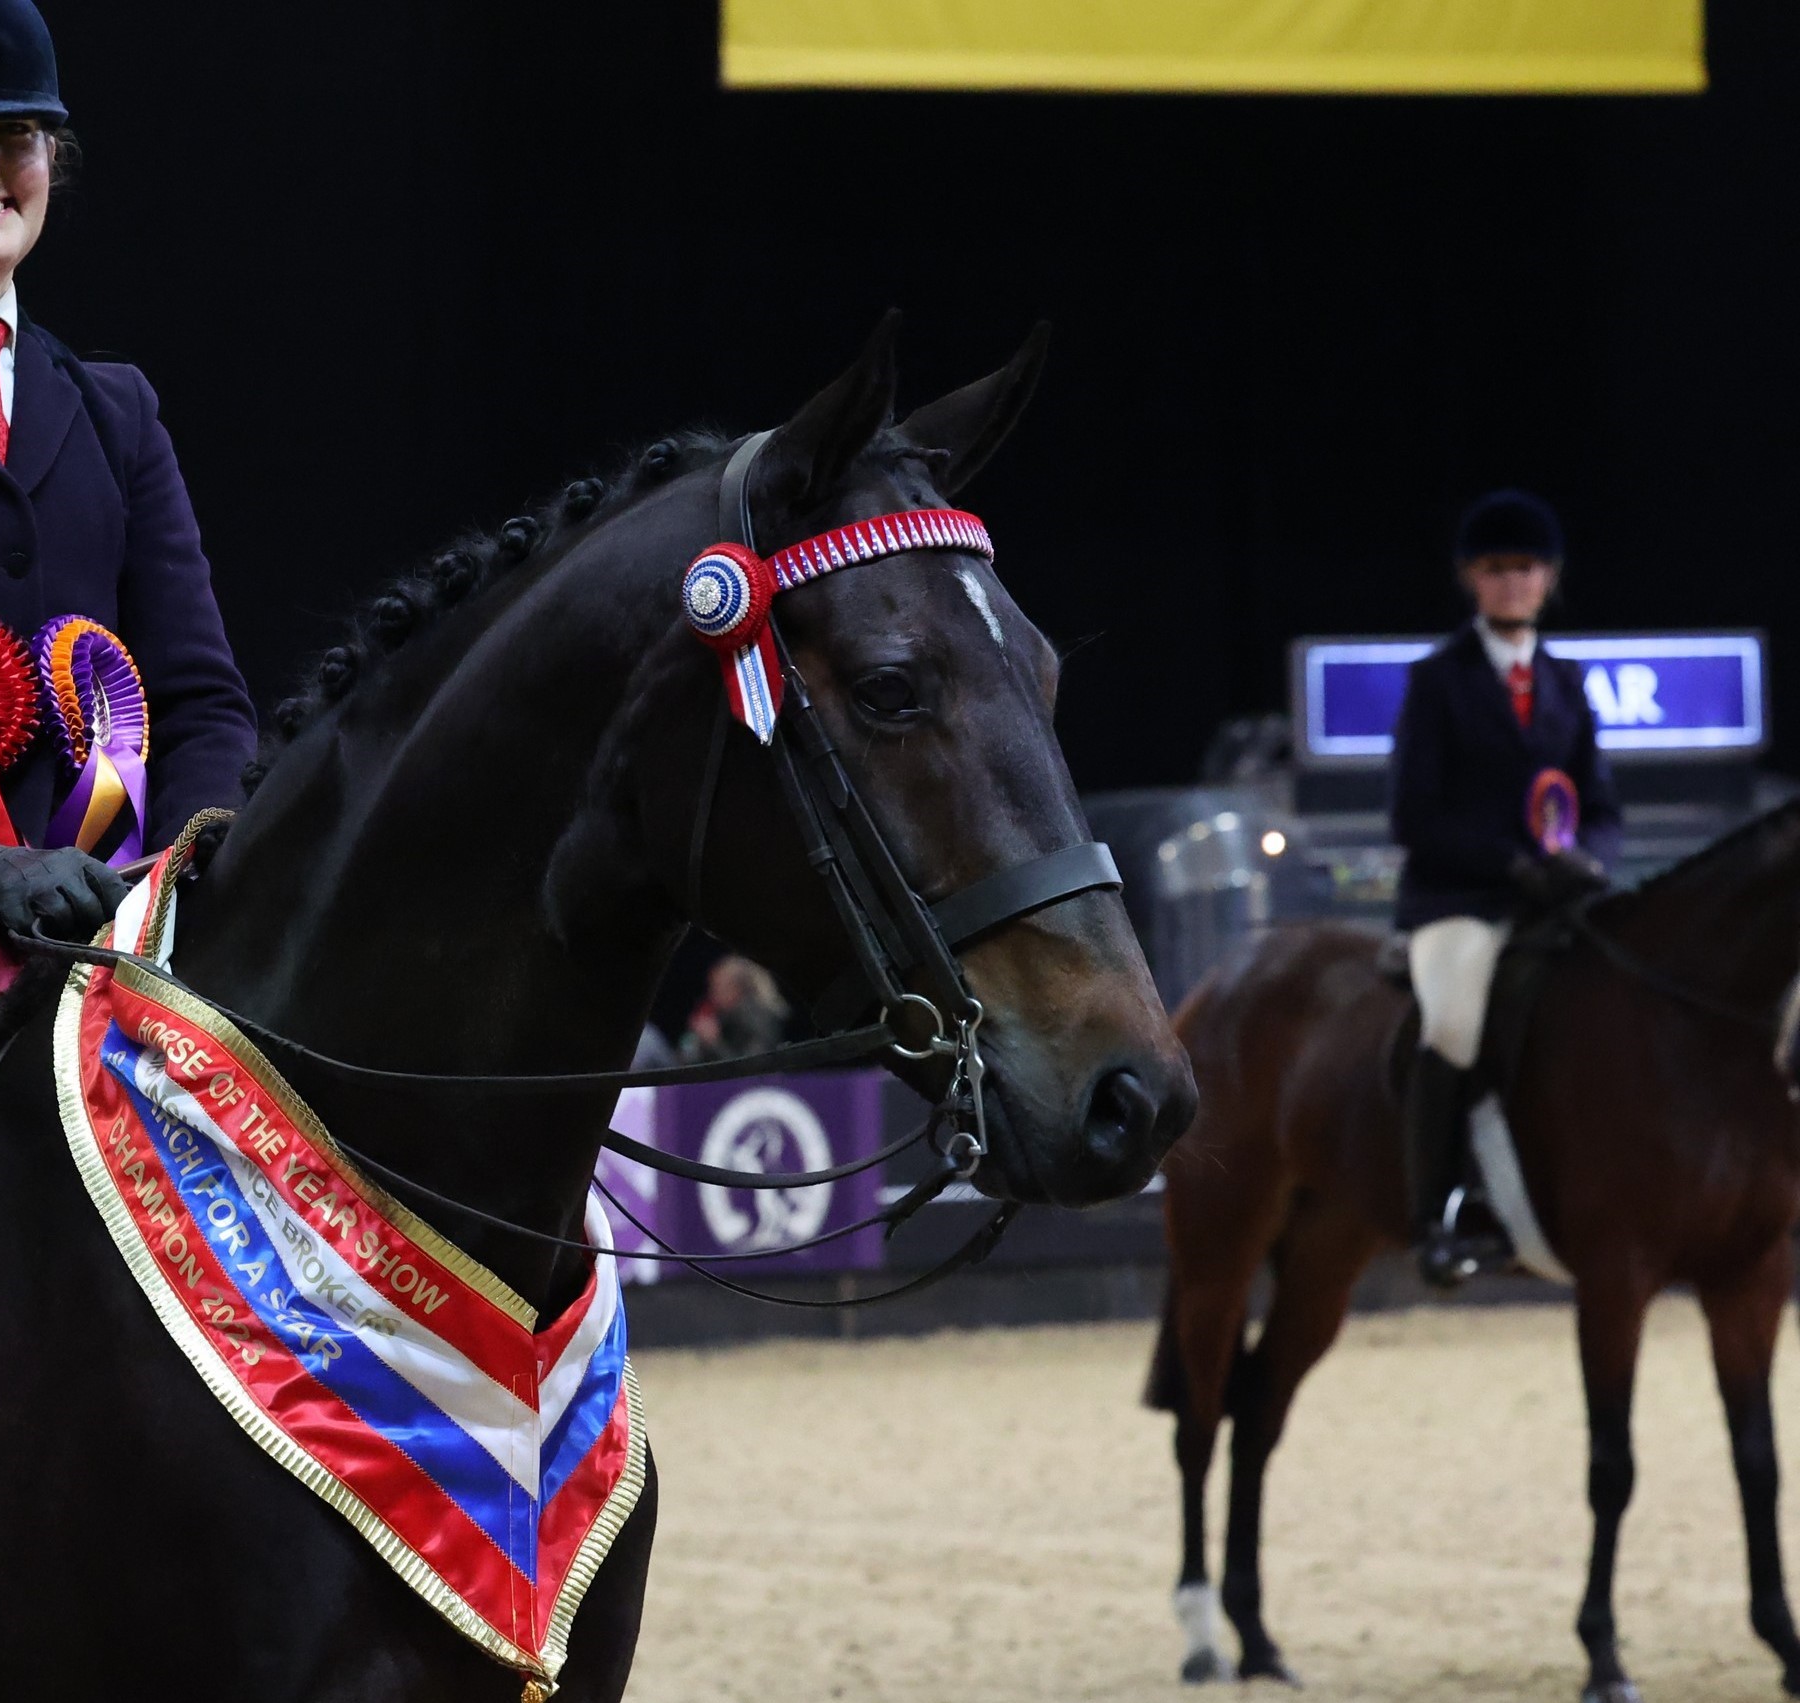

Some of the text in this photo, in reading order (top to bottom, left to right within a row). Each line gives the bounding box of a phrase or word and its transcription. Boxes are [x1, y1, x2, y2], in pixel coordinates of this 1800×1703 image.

[108, 1117, 204, 1289] CHAMPION
[201, 1287, 268, 1366] 2023
[138, 1016, 214, 1082] HORSE
[209, 1072, 245, 1108] OF
[239, 1103, 287, 1165] THE
[280, 1152, 358, 1240] YEAR
[355, 1231, 450, 1315] SHOW
[193, 1175, 251, 1257] FOR
[236, 1261, 267, 1288] A
[260, 1288, 343, 1372] STAR
